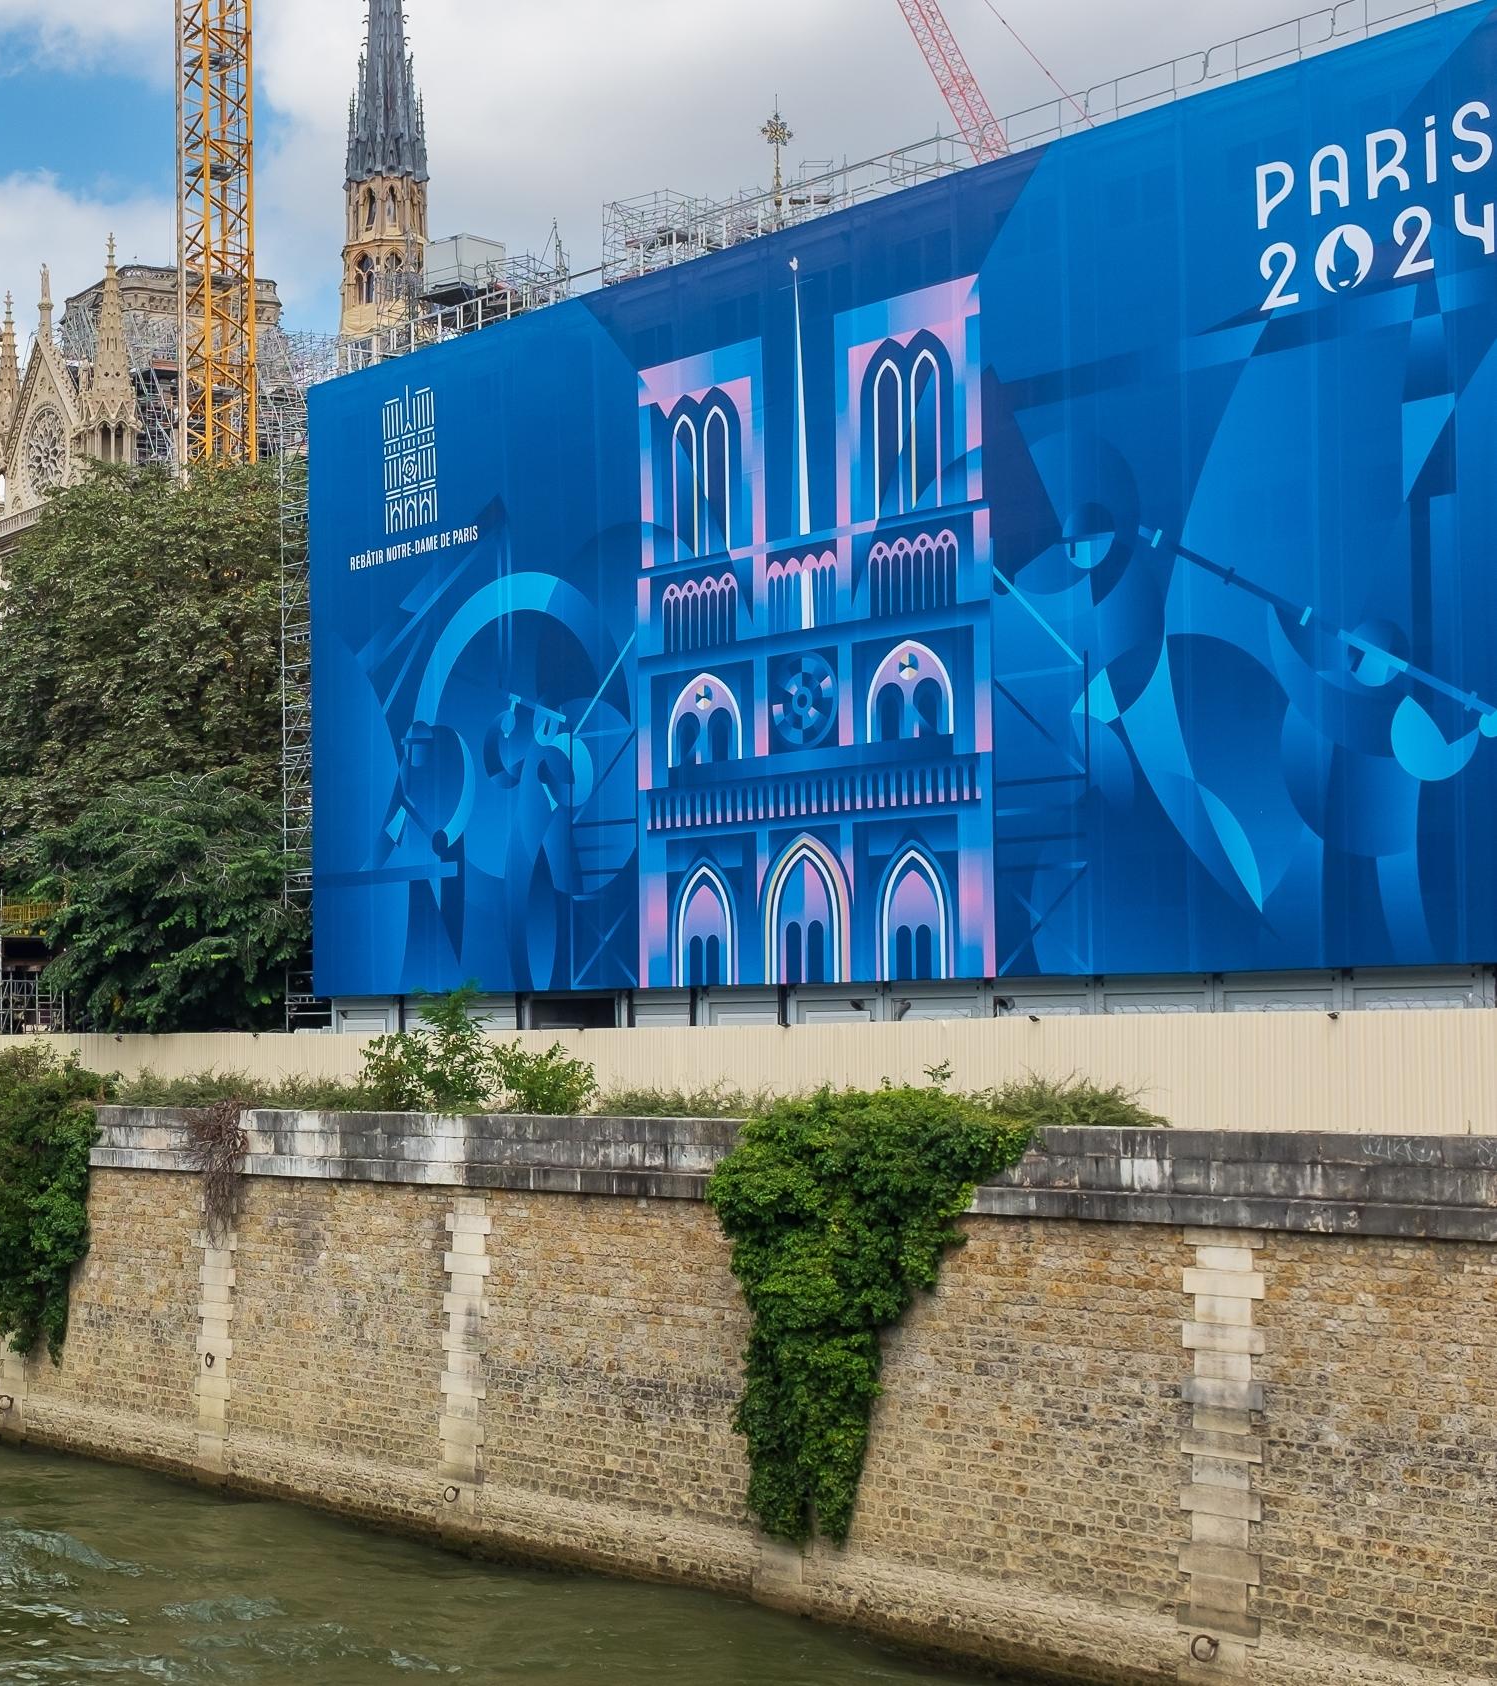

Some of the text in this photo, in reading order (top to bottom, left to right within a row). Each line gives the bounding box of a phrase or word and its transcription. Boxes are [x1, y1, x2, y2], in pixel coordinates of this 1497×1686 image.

[349, 525, 479, 572] REBÂTIR NOTRE-DAME DE PARIS
